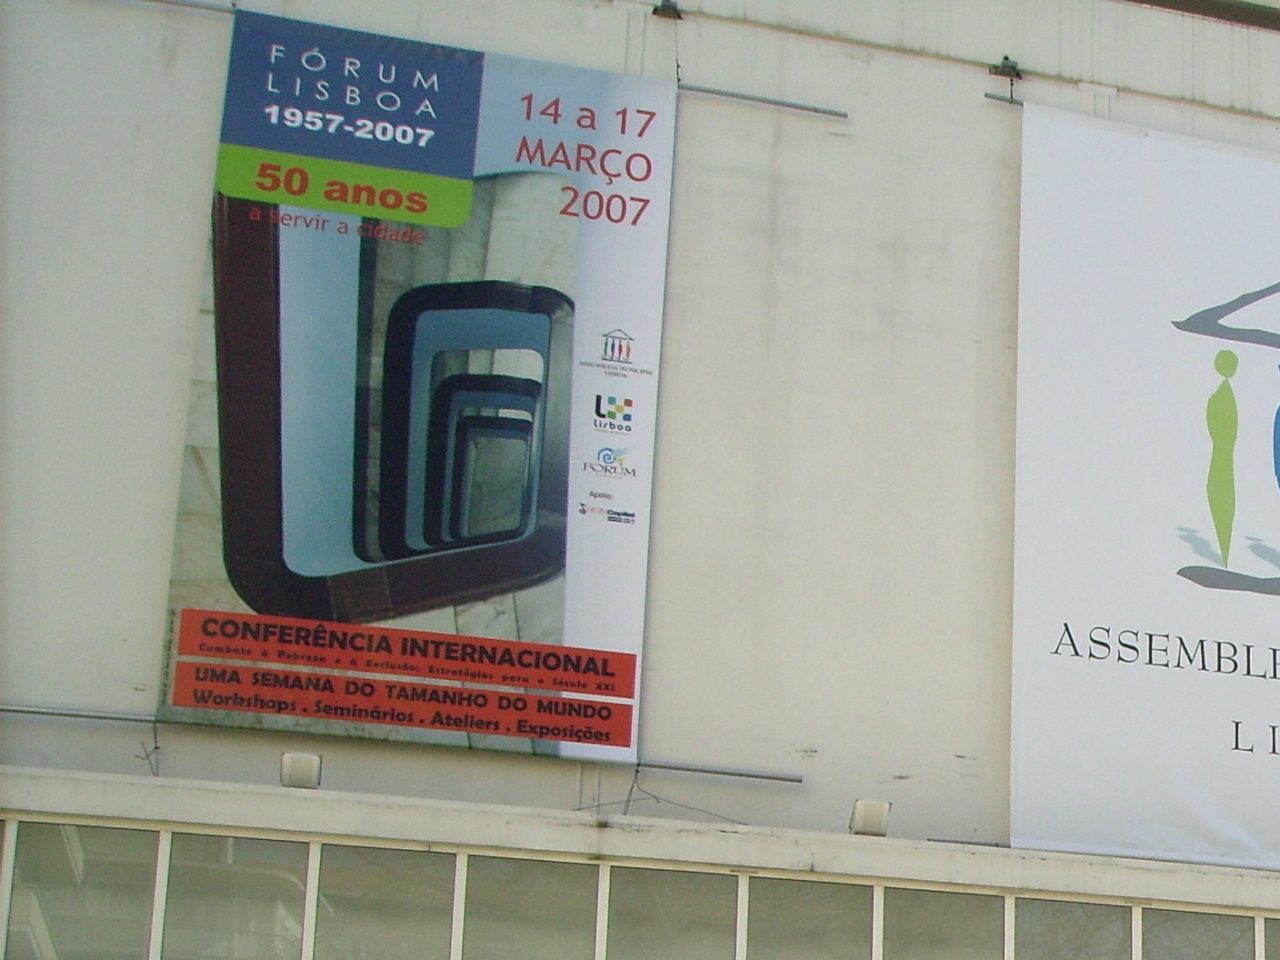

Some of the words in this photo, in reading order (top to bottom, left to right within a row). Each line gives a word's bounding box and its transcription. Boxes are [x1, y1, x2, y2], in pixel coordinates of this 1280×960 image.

[269, 44, 440, 93] FÓRUM
[266, 73, 438, 119] LISBOA
[519, 94, 562, 124] 14
[576, 108, 597, 130] a
[615, 108, 657, 139] 17
[264, 105, 435, 148] 1957-2007
[515, 137, 653, 185] MARÇO
[255, 162, 310, 197] 50
[323, 177, 429, 213] anos
[558, 186, 651, 227] 2007
[249, 210, 262, 223] a
[268, 210, 330, 232] servir
[337, 222, 349, 236] a
[356, 220, 426, 246] cidade
[593, 419, 632, 432] Lisboa
[201, 617, 393, 655] CONFERÊNCIA
[400, 637, 615, 678] INTERNACIONAL
[193, 666, 242, 685] UMA
[251, 671, 335, 694] SEMANA
[344, 681, 376, 697] DO
[385, 684, 489, 708] TAMANHO
[497, 696, 528, 712] DO
[536, 700, 613, 721] MUNDO
[595, 682, 615, 692] XXI
[192, 688, 297, 714] Workshops
[314, 700, 414, 723] Seminários
[430, 711, 500, 732] Ateliers
[516, 719, 611, 743] Exposições
